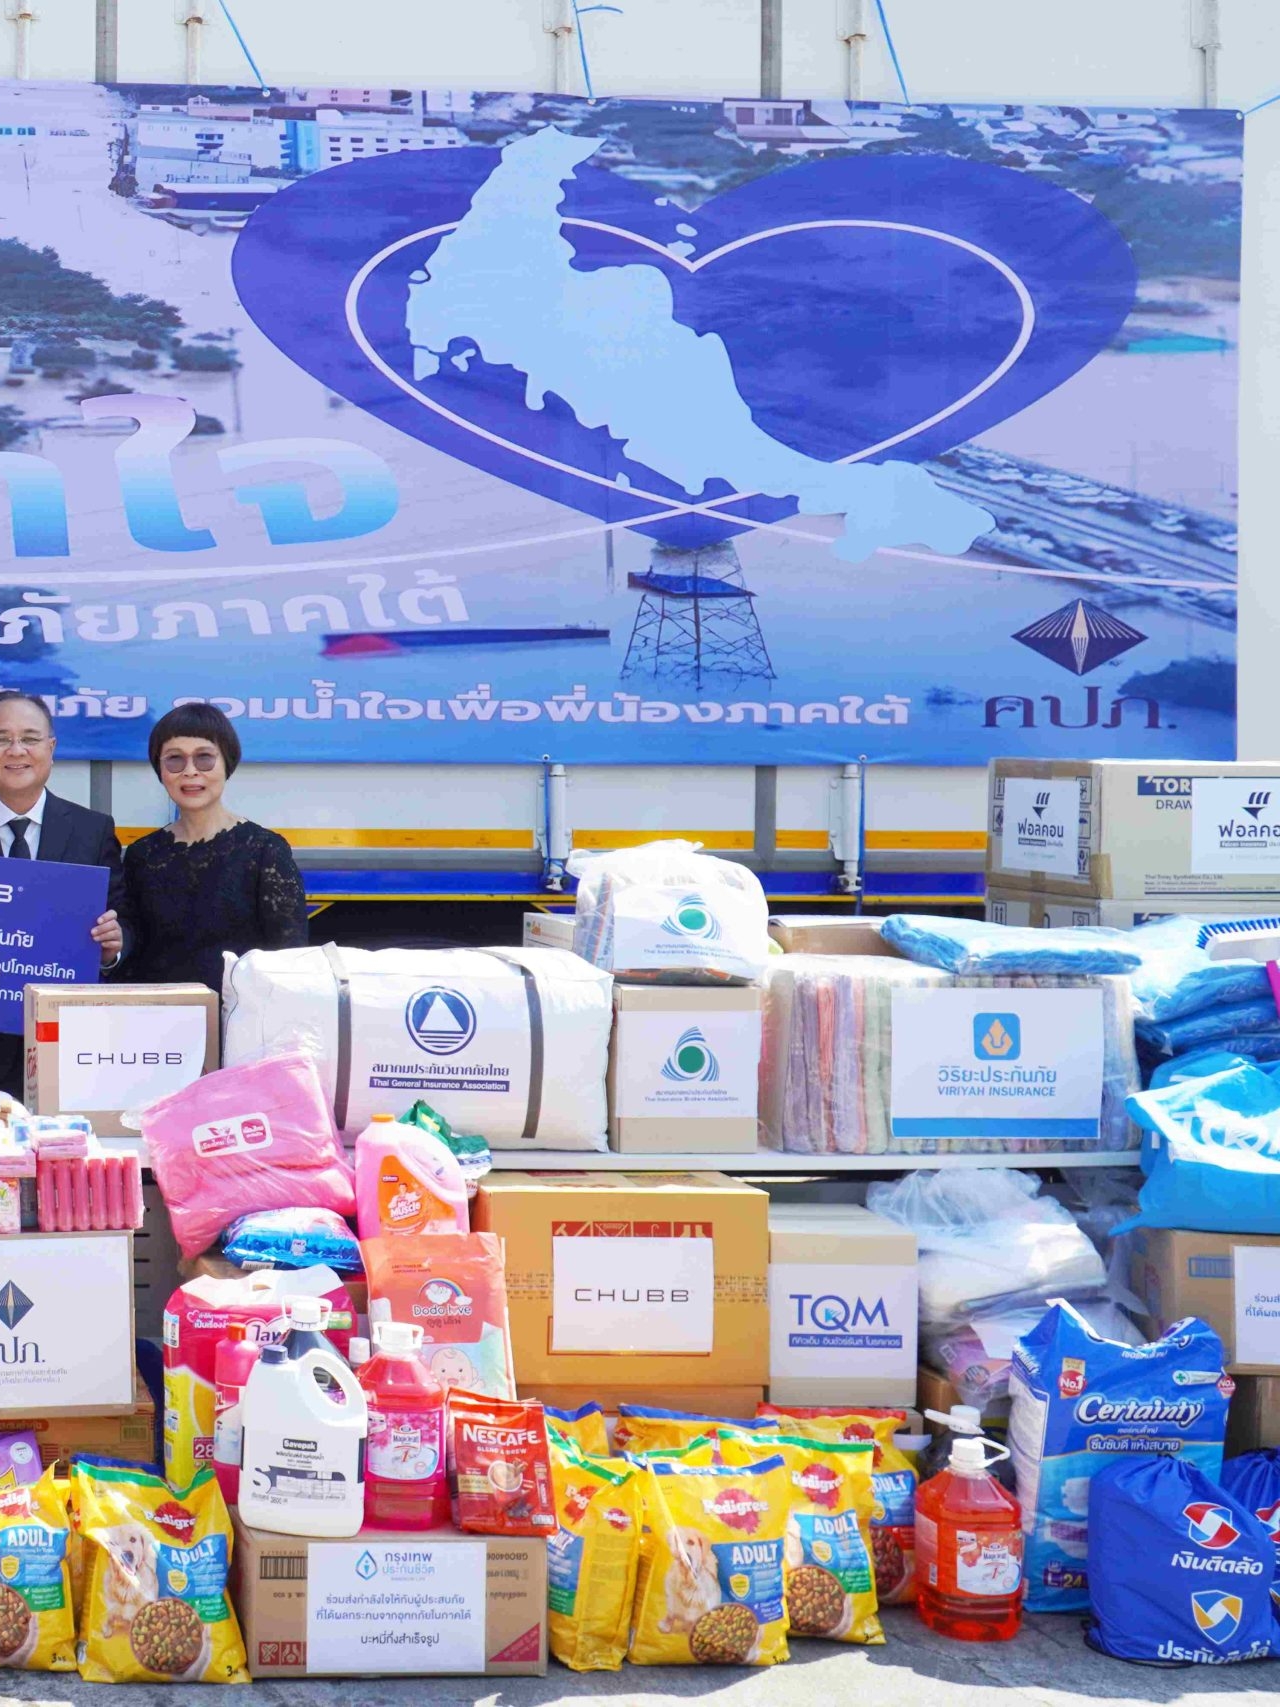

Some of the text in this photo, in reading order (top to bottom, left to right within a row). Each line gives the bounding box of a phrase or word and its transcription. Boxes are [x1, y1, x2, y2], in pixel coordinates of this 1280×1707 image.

[981, 685, 1178, 730] คปภ.
[1018, 818, 1064, 838] ฟอลคอน
[77, 1053, 183, 1065] CHUBB
[371, 1062, 510, 1078] สมาคมประกันวินาศภัยไทย
[938, 1065, 1057, 1083] วิริยะประกันภัย
[373, 1079, 508, 1091] Thai General Insurance Association
[938, 1086, 1056, 1097] VIRIYAH INSURANCE
[574, 1288, 689, 1302] CHUBB
[413, 1304, 446, 1316] Dodo
[789, 1294, 889, 1333] TQM
[1059, 1375, 1084, 1389] No.1
[1078, 1395, 1204, 1429] Certainty
[194, 1443, 214, 1459] 28
[283, 1439, 317, 1451] Savepak
[1130, 1438, 1179, 1451] แห้งสบาย
[702, 1498, 769, 1517] Pedigree
[814, 1511, 859, 1535] ADULT
[7, 1529, 55, 1547] ADULT
[171, 1539, 215, 1566] ADULT
[384, 1551, 433, 1562] กรุงเทพ
[732, 1543, 778, 1565] ADULT
[382, 1562, 436, 1576] ประกันชีวิต
[1171, 1550, 1264, 1576] เงินติดล้อ
[360, 1631, 440, 1647] บะหมี่กึ่งสำเร็จรูป
